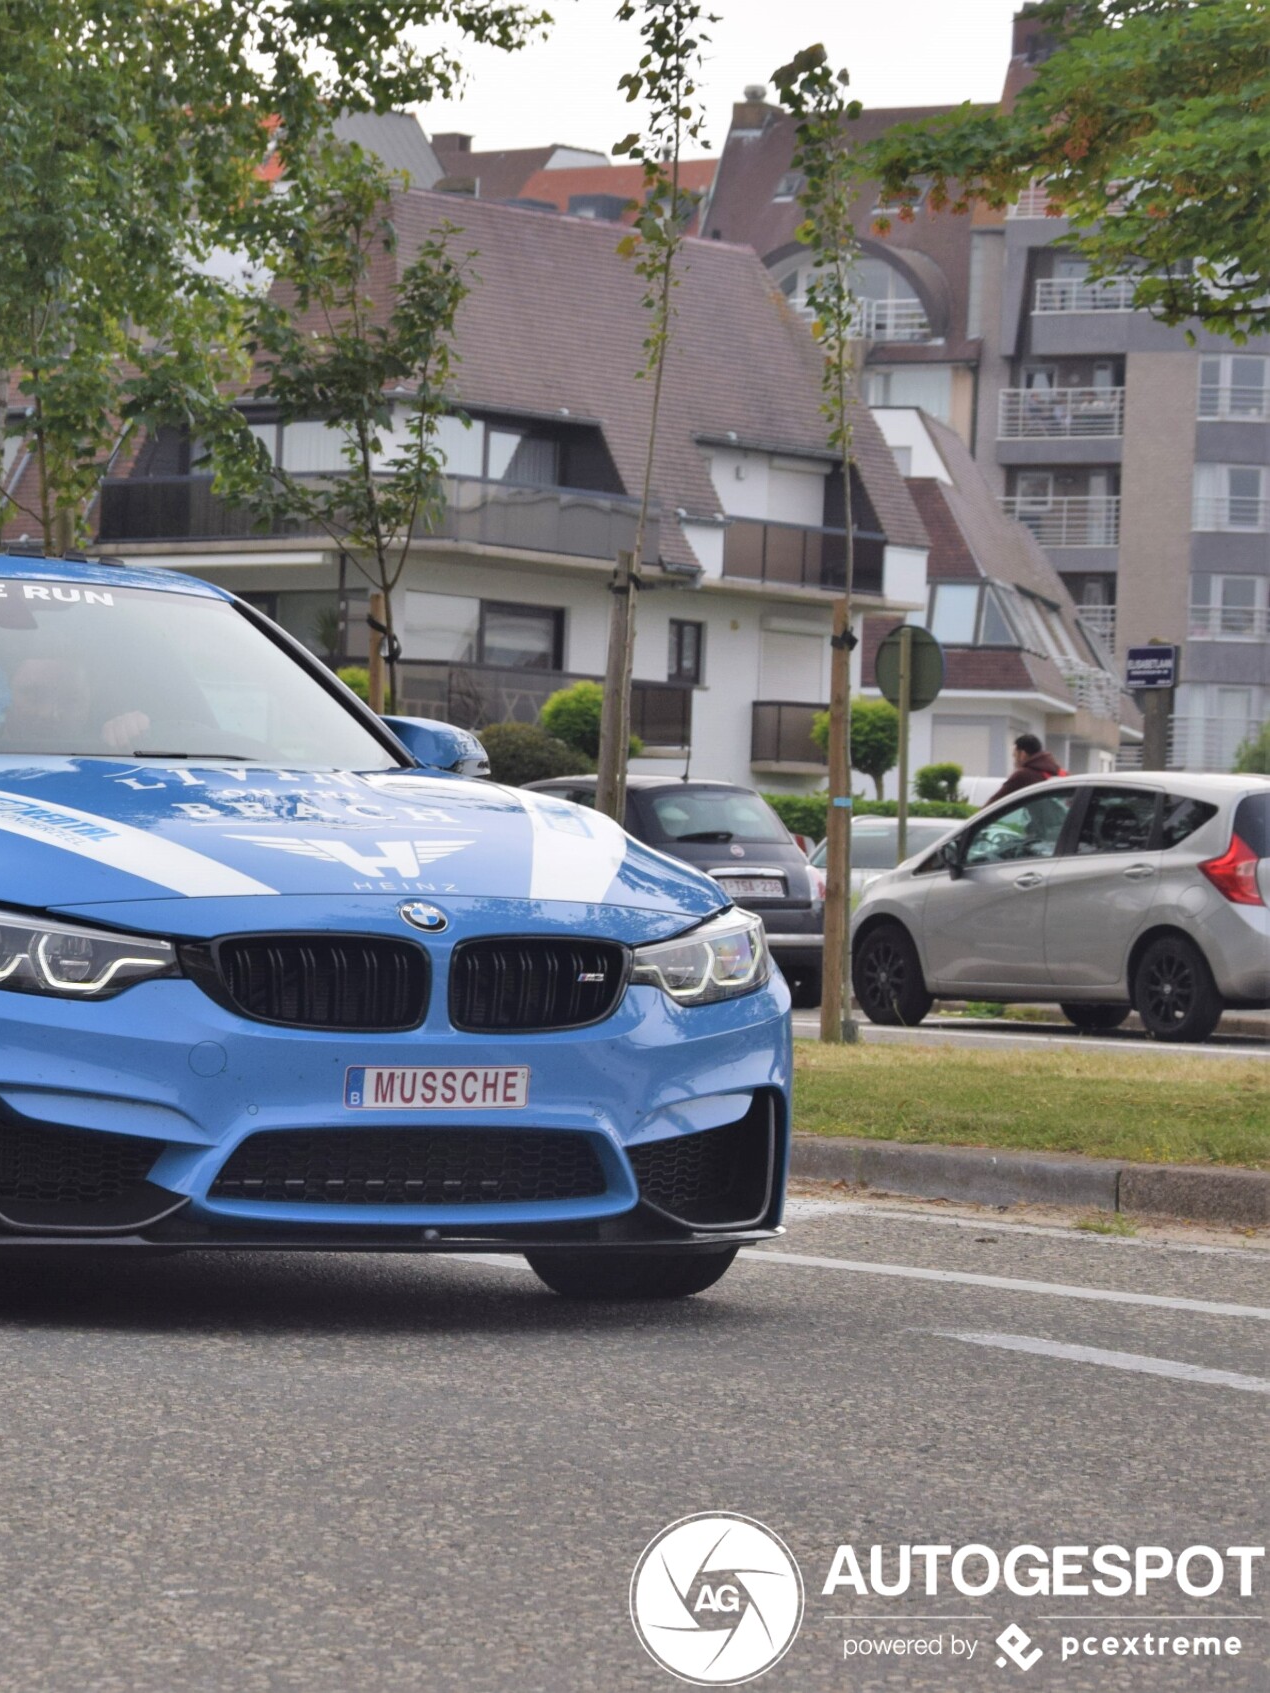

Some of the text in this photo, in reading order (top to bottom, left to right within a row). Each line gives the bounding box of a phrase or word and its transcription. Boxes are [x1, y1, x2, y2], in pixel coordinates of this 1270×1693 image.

[22, 584, 114, 606] RUN
[221, 788, 274, 797] ON
[171, 802, 462, 823] BEACH
[353, 881, 460, 892] HEINZ
[350, 1071, 518, 1105] B MUSSCHE
